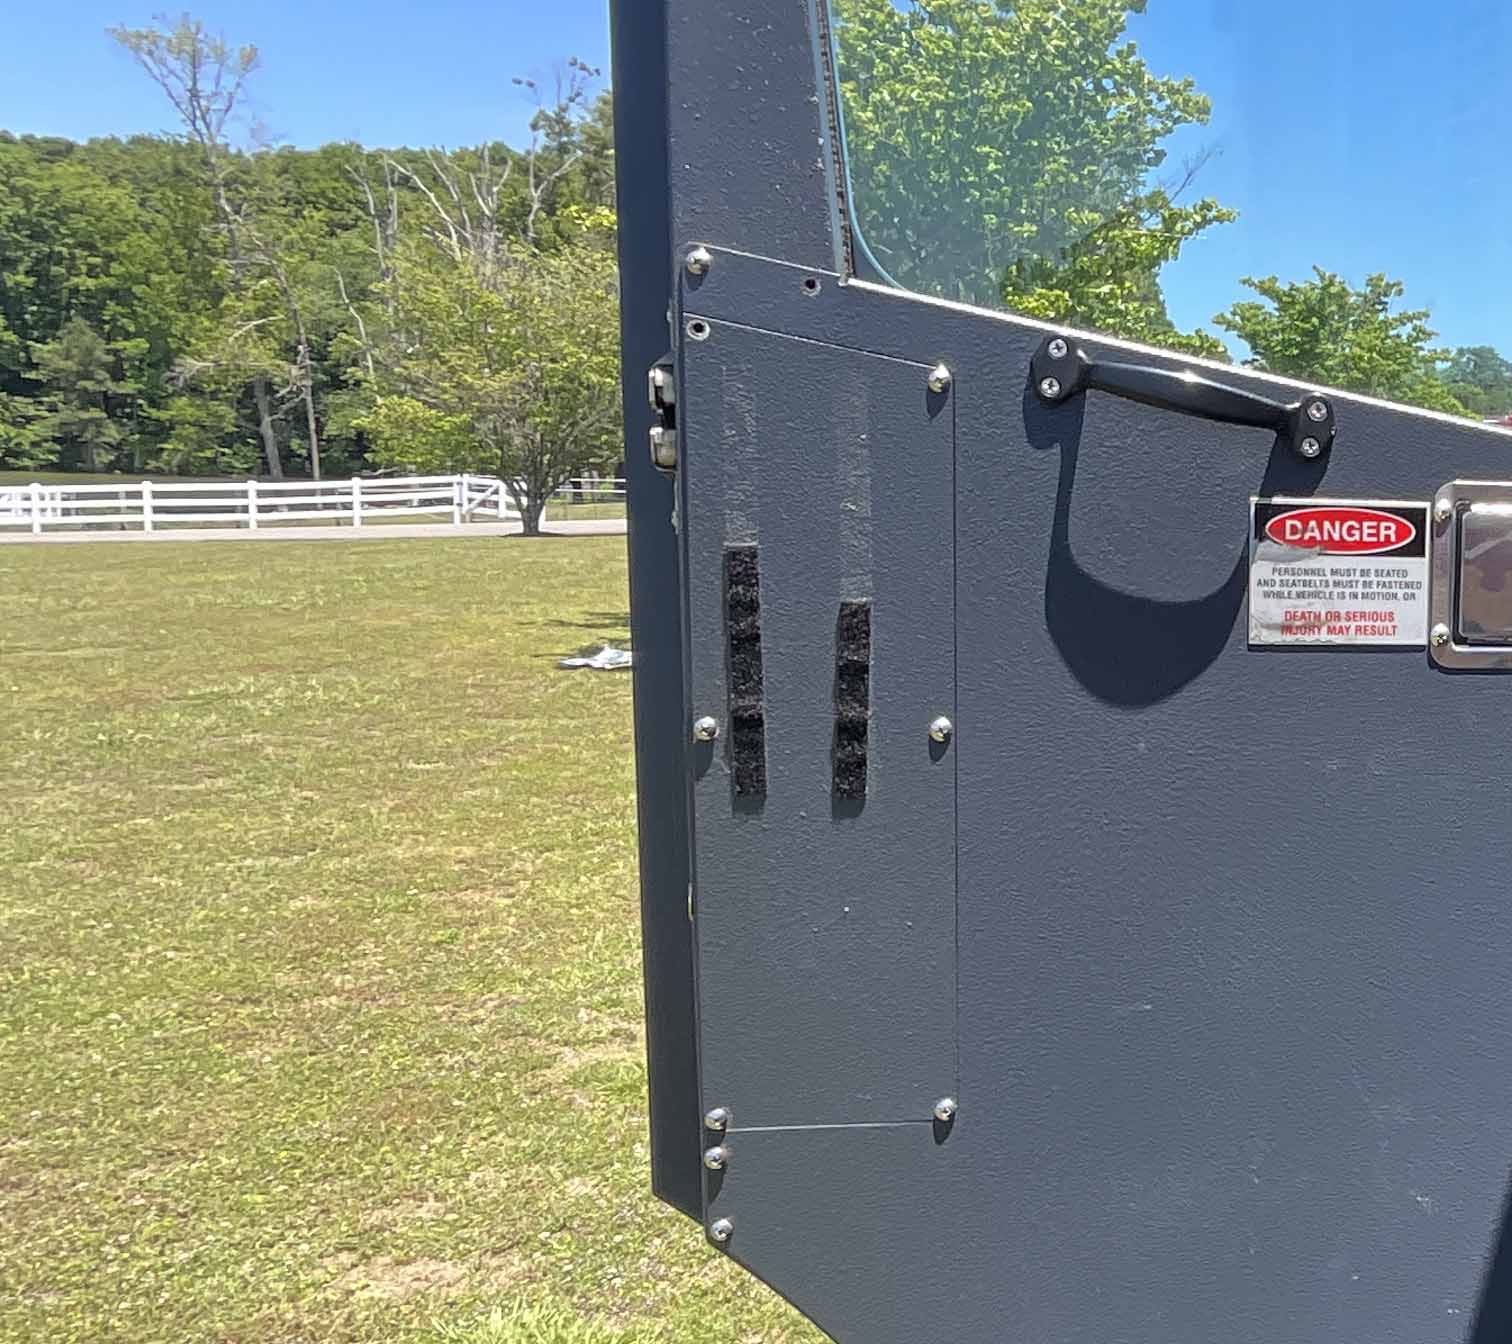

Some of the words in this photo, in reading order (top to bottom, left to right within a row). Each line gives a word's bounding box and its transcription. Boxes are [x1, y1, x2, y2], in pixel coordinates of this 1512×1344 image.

[1283, 519, 1397, 542] DANGER
[1271, 567, 1327, 577] PERSONNEL
[1330, 568, 1357, 577] MUST
[1360, 569, 1372, 578] BE
[1374, 569, 1409, 578] SEATED
[1256, 578, 1277, 588] AND
[1279, 579, 1330, 588] SEATBELTS
[1332, 580, 1359, 589] MUST
[1362, 580, 1374, 590] BE
[1376, 581, 1423, 590] FASTENED
[1262, 590, 1292, 600] WHILE
[1295, 591, 1335, 600] VEHICLE
[1337, 591, 1346, 601] IS
[1348, 592, 1359, 601] IN
[1403, 592, 1417, 601] OR
[1284, 610, 1322, 622] DEATH
[1325, 611, 1341, 622] OR
[1343, 611, 1396, 623] SERIOUS
[1281, 625, 1322, 636] INJURY
[1326, 625, 1352, 636] MAY
[1354, 625, 1398, 637] RESULT
